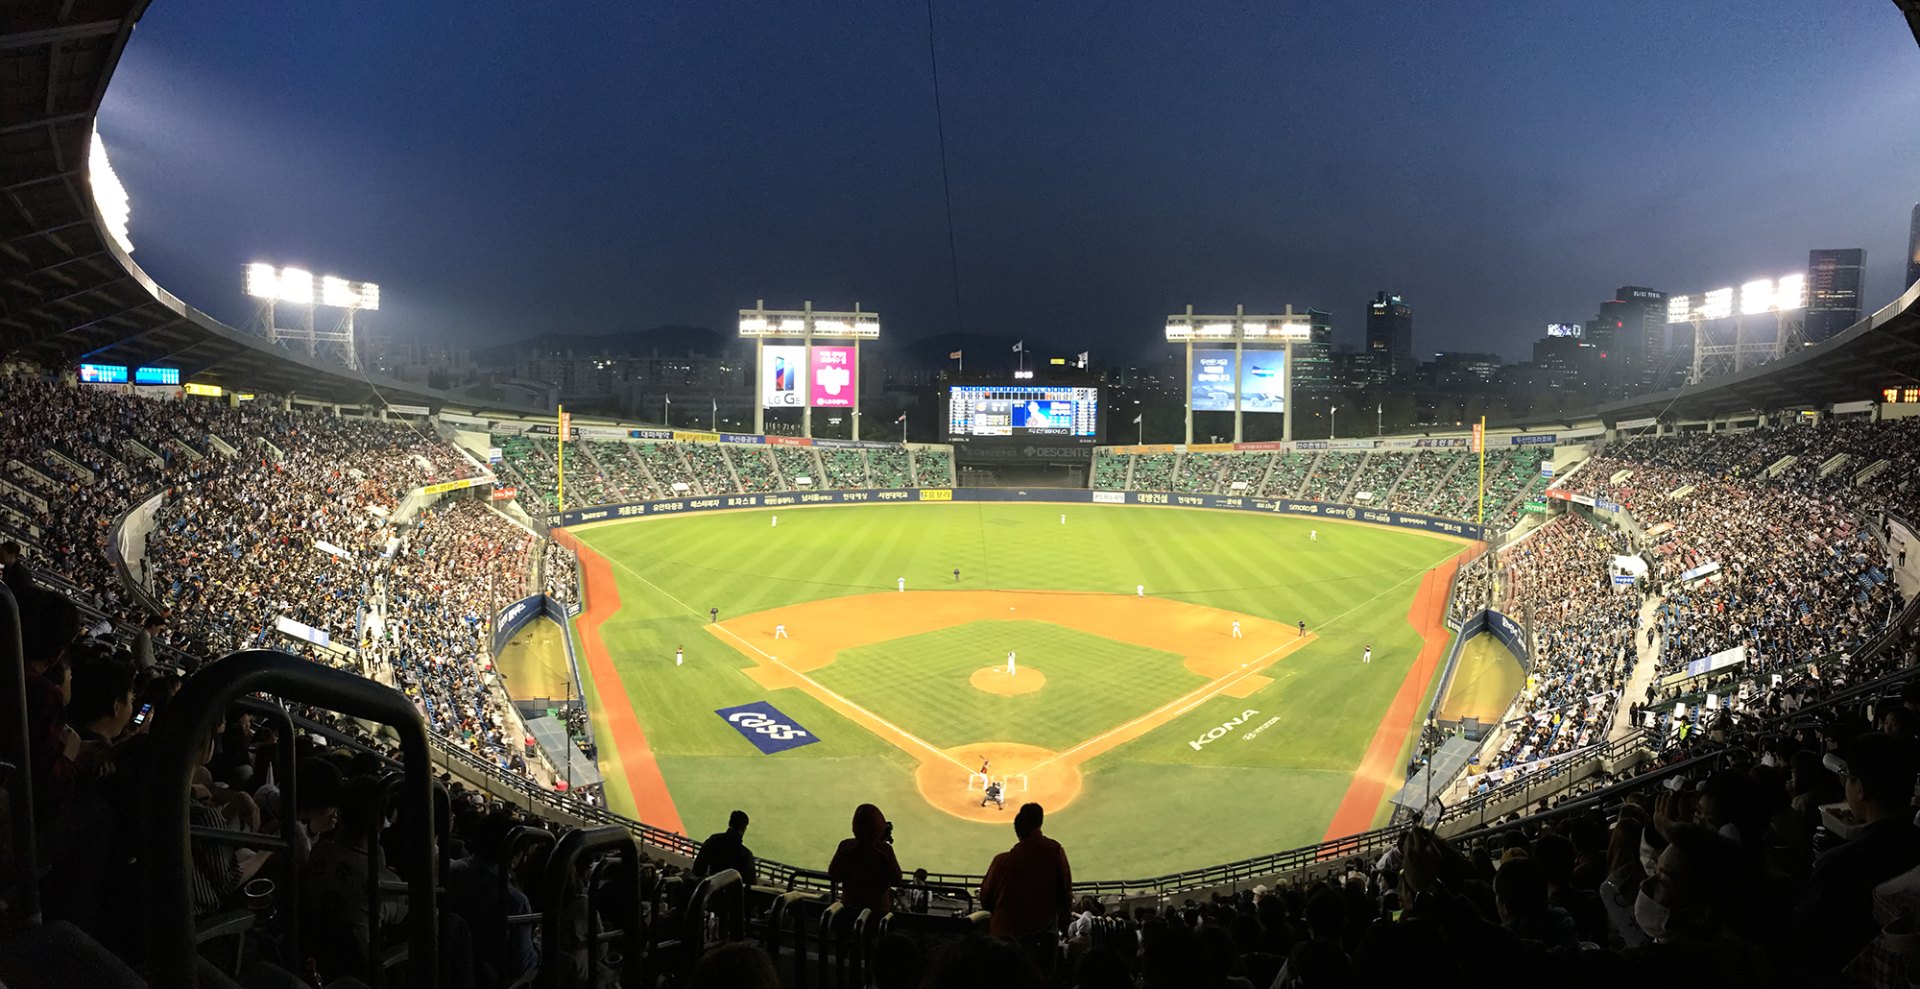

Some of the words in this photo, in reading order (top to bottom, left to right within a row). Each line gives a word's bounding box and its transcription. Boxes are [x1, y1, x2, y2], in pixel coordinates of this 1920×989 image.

[768, 396, 781, 405] LG
[1036, 447, 1089, 457] DESCENTE
[1137, 493, 1168, 504] 대방건설
[618, 505, 645, 516] 키움증권
[653, 502, 684, 512] 유안타증권
[1188, 709, 1260, 751] KONA
